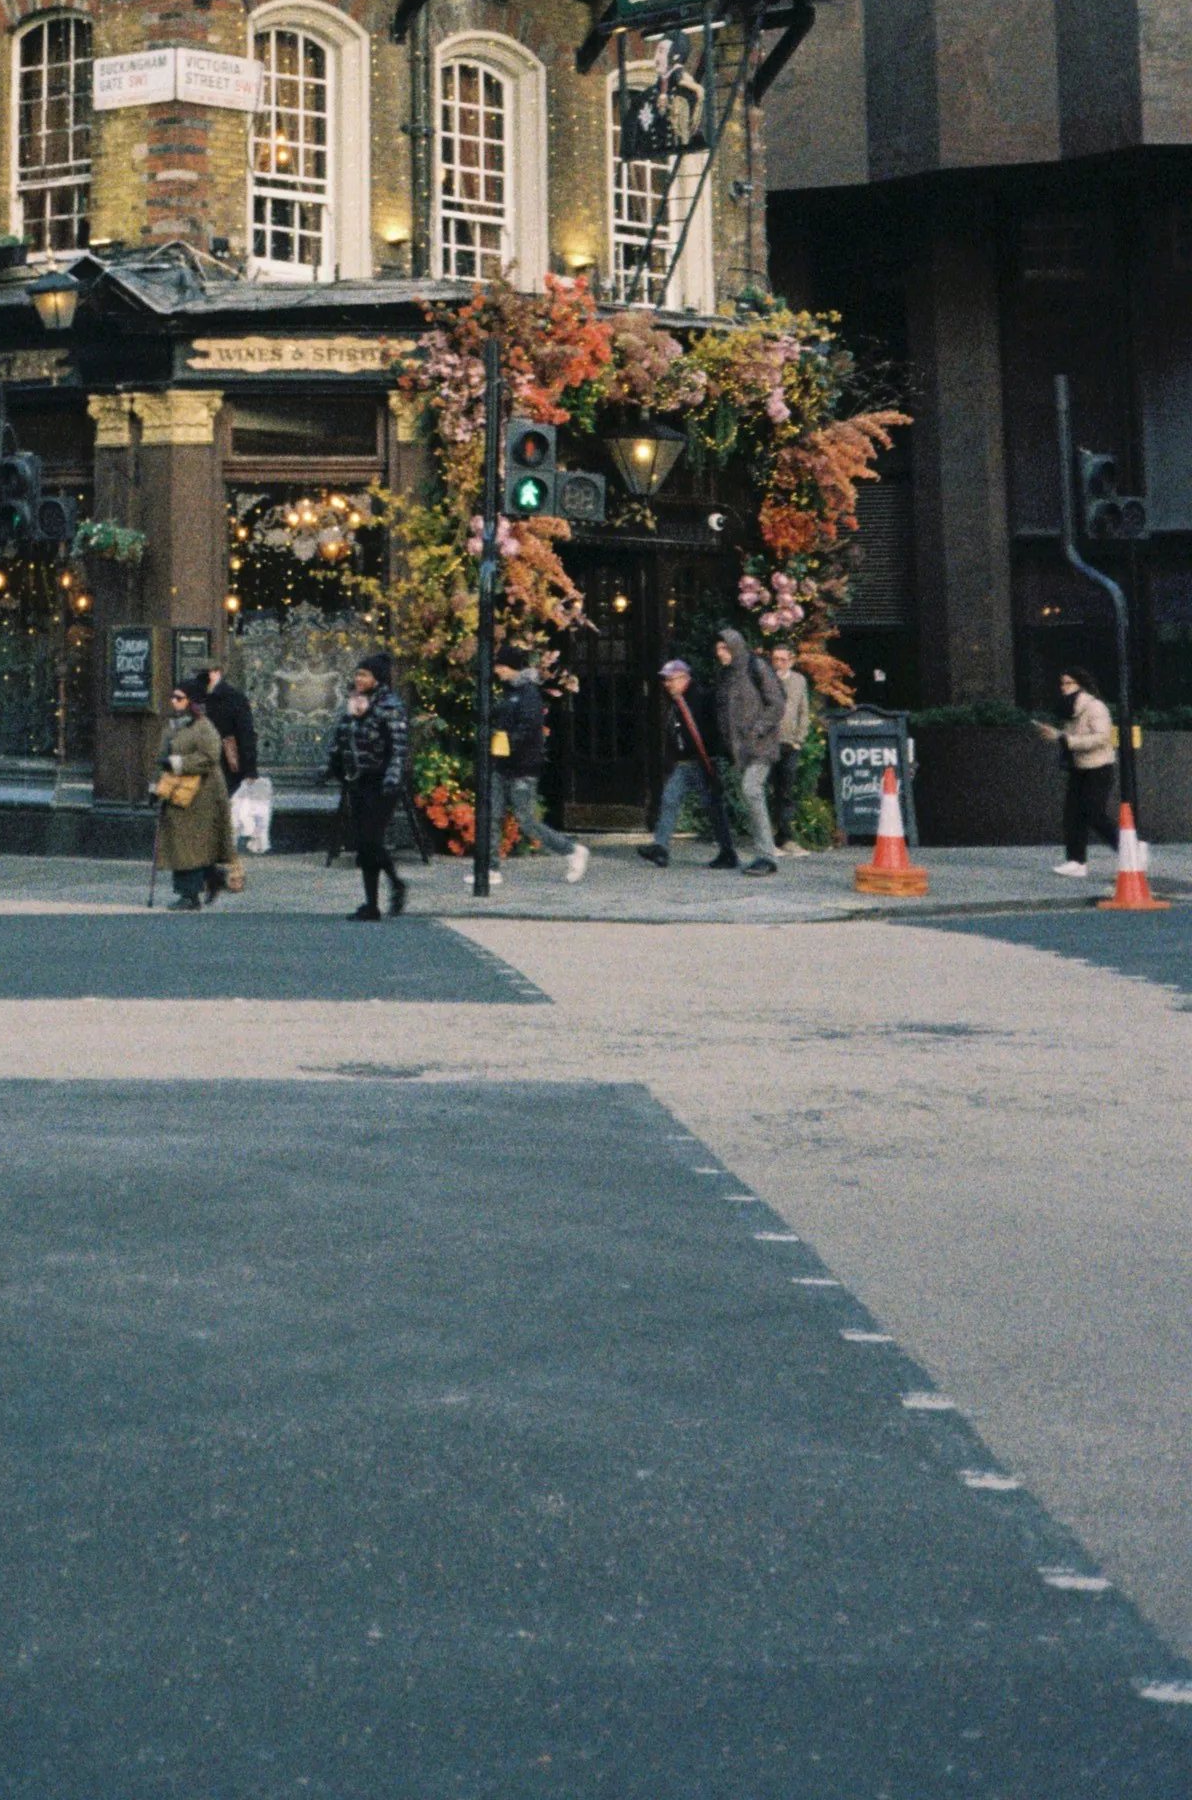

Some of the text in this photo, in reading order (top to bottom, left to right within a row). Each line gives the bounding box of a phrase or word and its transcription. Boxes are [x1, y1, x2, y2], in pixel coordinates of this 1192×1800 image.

[100, 54, 167, 77] BUCKINGHAM
[185, 56, 242, 75] VICTORIA
[100, 77, 124, 92] GATE
[184, 72, 230, 90] STREET
[218, 347, 283, 363] WINES
[840, 747, 898, 766] OPEN
